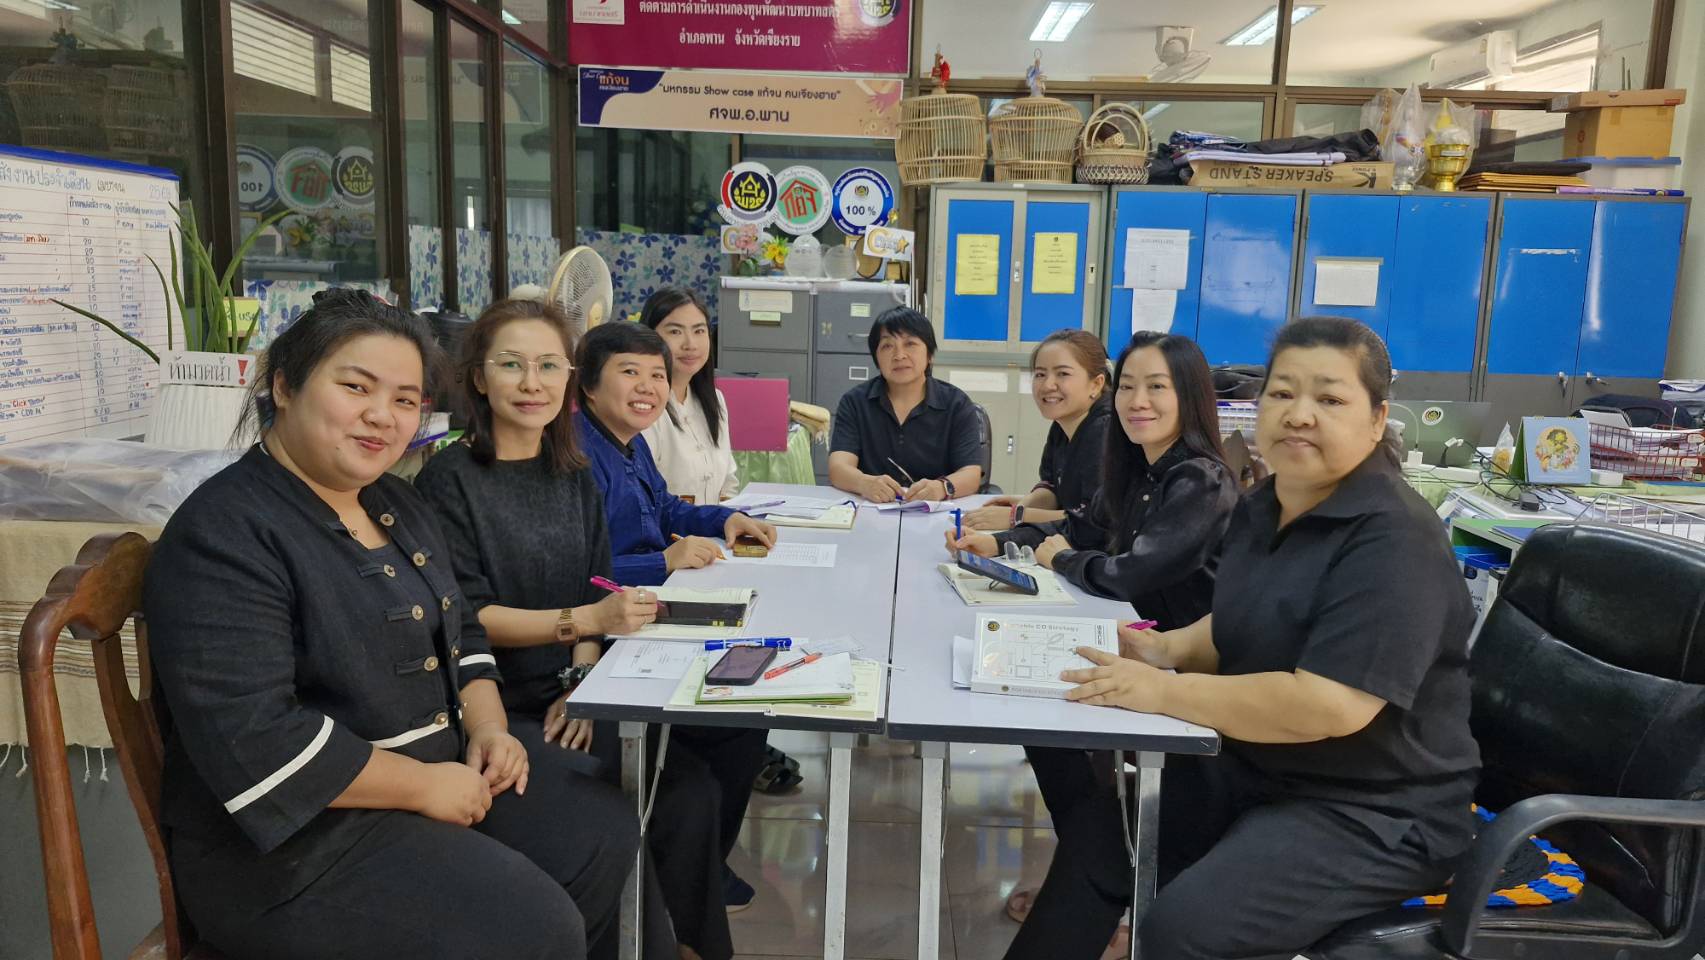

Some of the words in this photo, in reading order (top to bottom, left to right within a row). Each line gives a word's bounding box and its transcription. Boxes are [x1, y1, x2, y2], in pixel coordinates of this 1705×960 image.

[679, 28, 725, 45] อำเภอพาน
[734, 28, 801, 47] จังหวัดเชียงราย
[703, 86, 729, 96] Show
[732, 88, 754, 97] case
[1209, 166, 1262, 180] STAND
[1266, 167, 1334, 182] SPEAKER
[846, 205, 865, 215] 100
